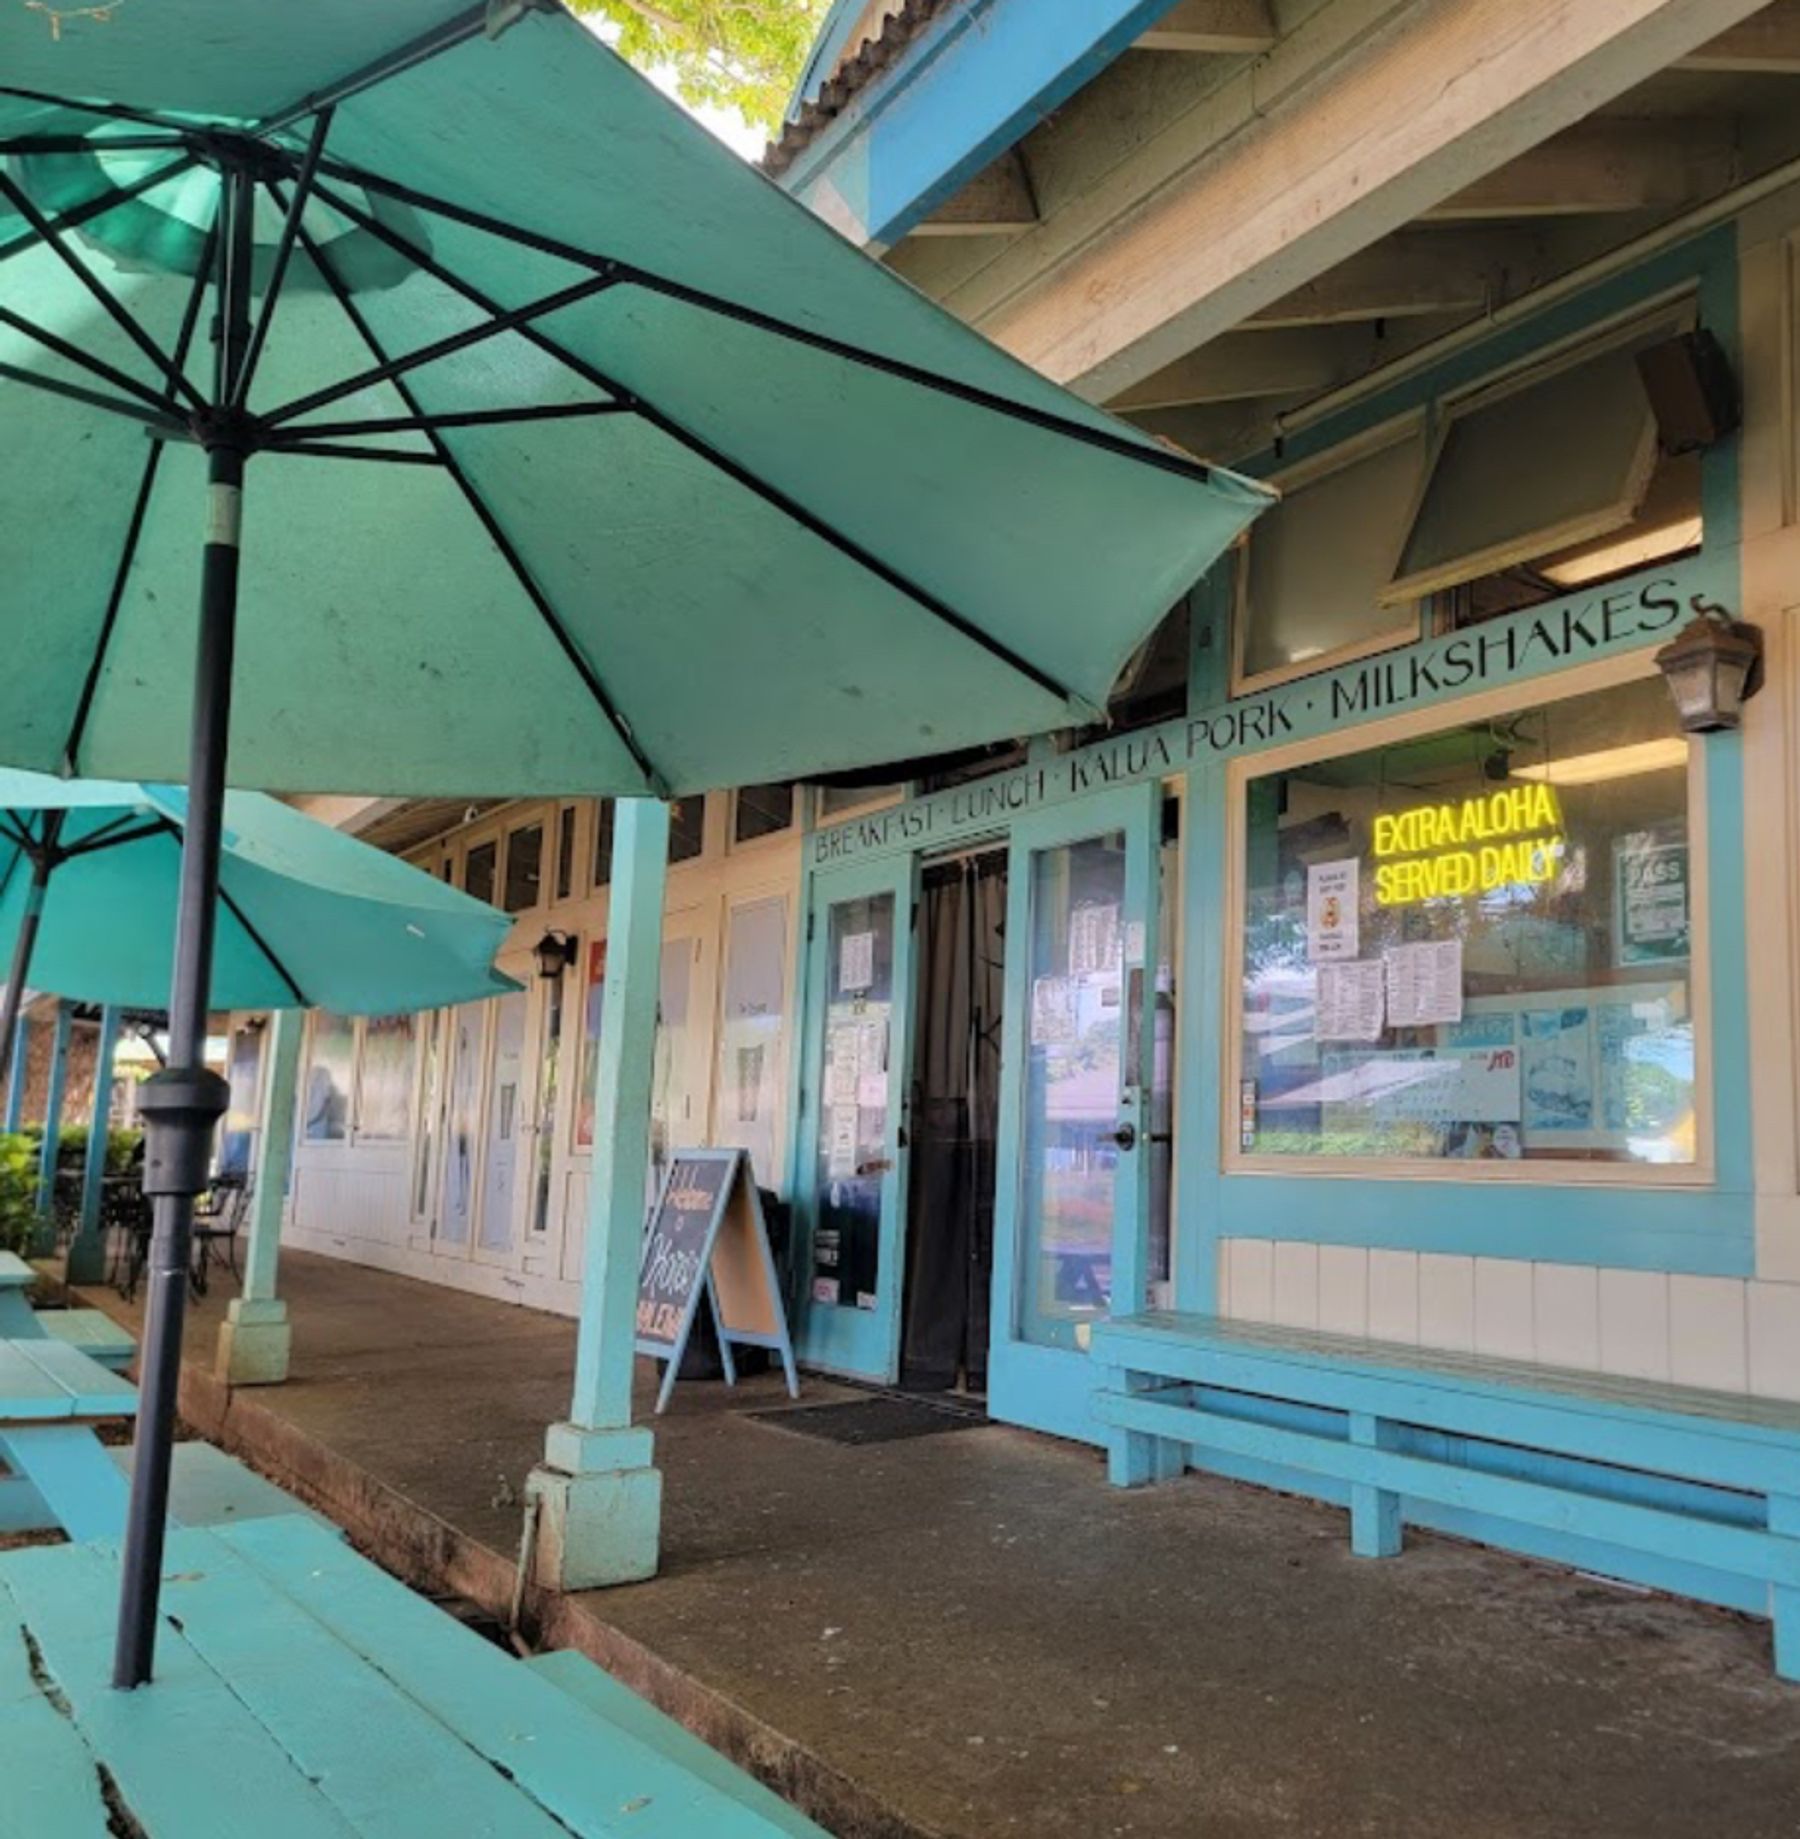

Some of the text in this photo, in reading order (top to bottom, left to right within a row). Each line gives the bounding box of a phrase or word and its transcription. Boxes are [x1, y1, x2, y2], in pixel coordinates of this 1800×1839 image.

[815, 578, 1682, 863] BREAKFAST LUNCH KALUA PORK MILKSHAKES
[1374, 782, 1557, 856] EXTRA ALOHA
[1375, 836, 1560, 905] SERVED DAILY
